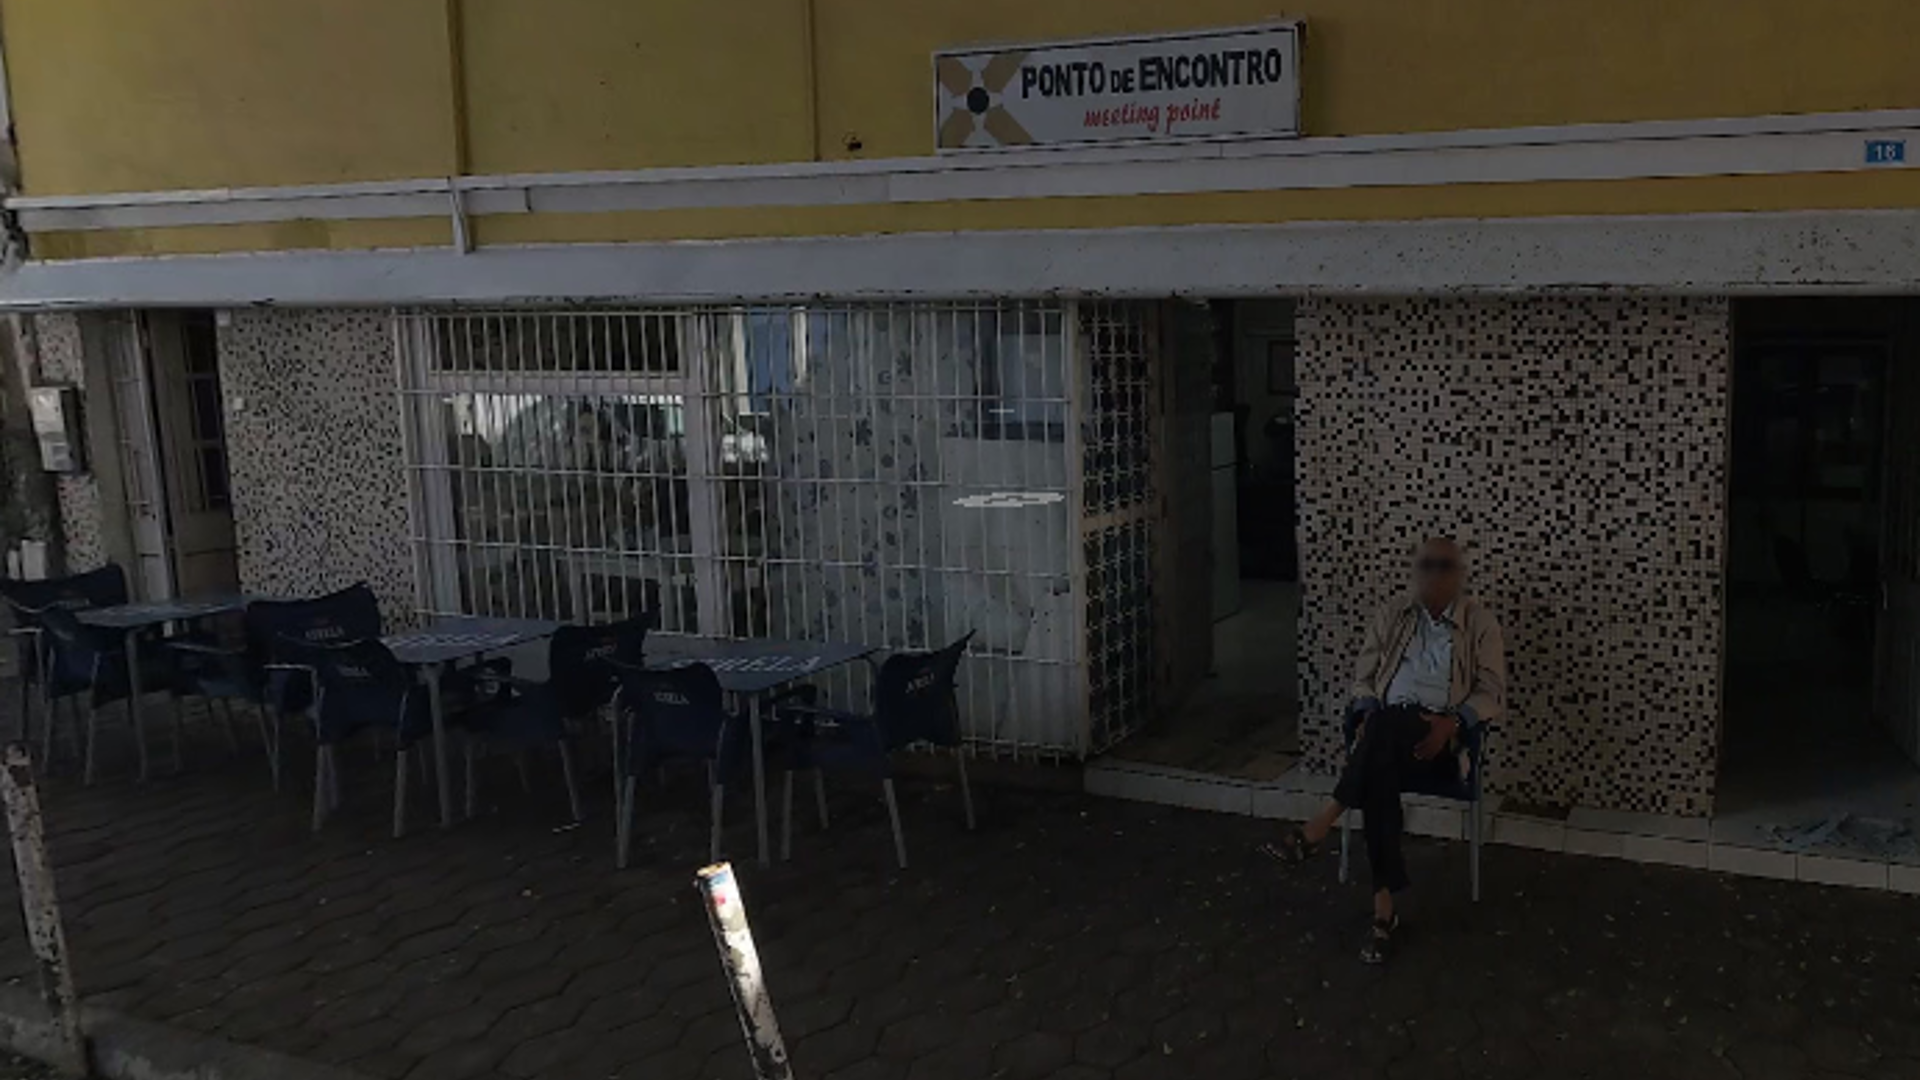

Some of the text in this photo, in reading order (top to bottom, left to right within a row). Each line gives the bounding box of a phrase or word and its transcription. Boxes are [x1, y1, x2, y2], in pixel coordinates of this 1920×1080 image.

[1021, 48, 1282, 99] PONTO DE ENCONTRO
[1084, 97, 1221, 135] meeting point
